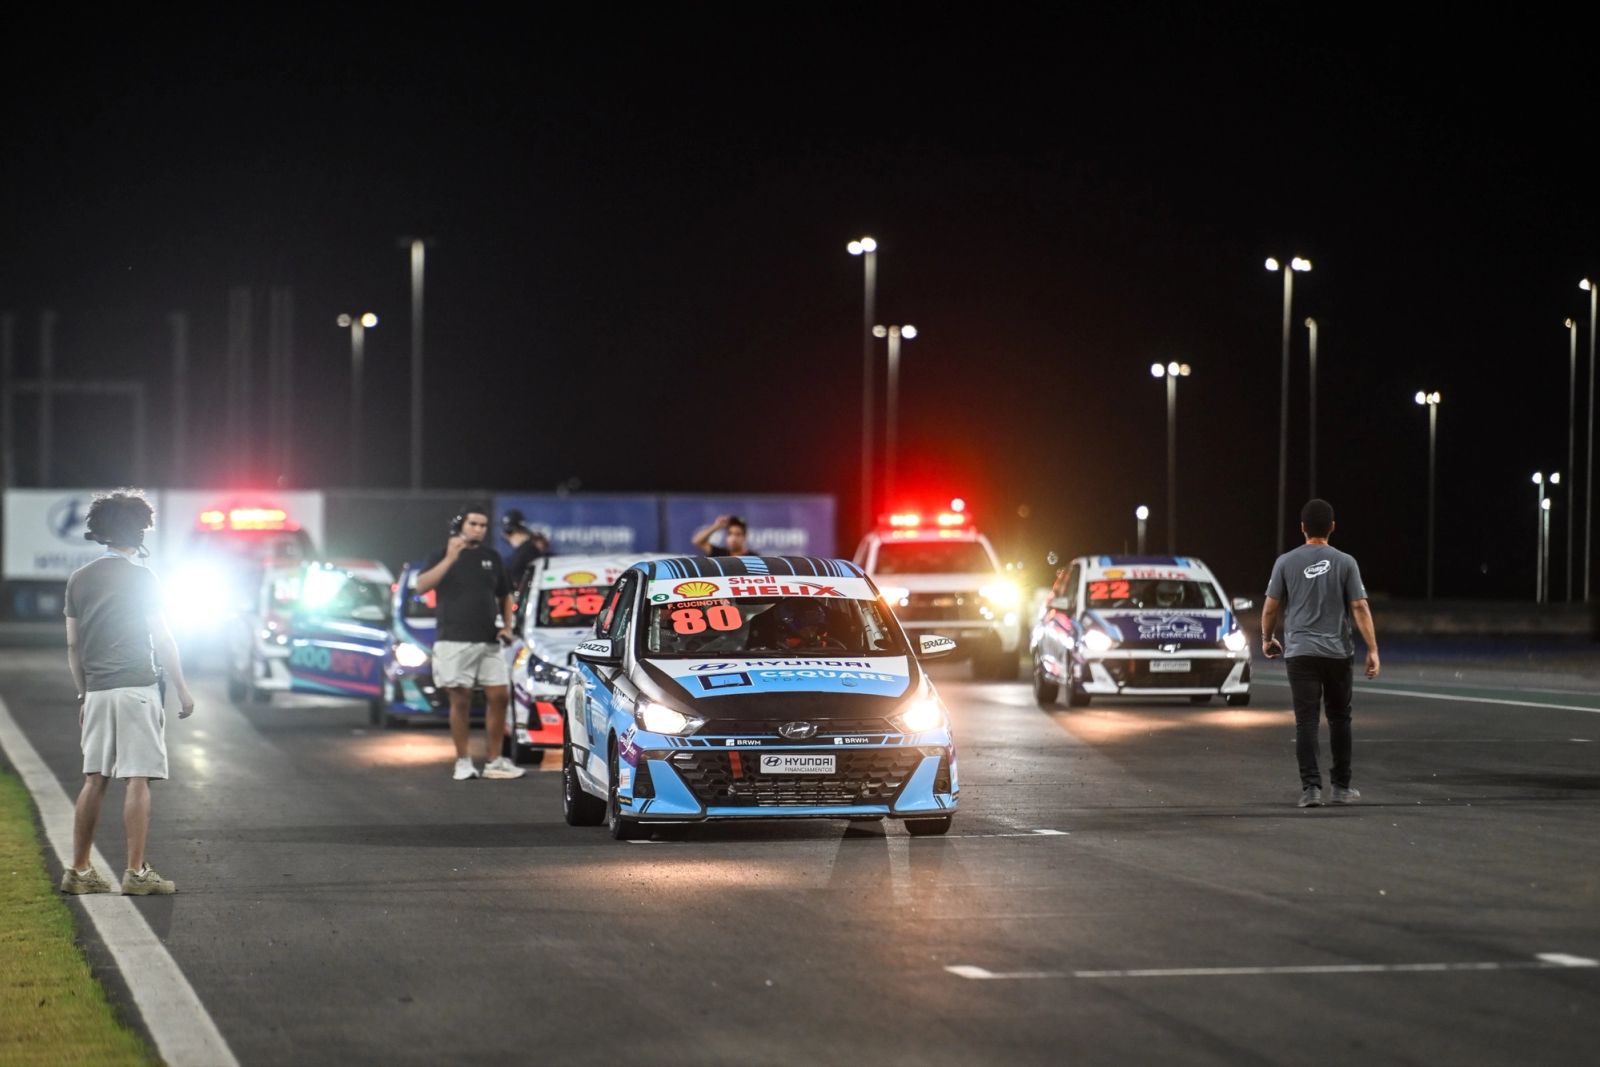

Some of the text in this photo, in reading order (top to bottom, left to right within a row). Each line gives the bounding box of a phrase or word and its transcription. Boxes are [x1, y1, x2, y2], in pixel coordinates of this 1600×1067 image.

[728, 576, 776, 585] Shell
[729, 584, 845, 597] HELIX
[1088, 579, 1131, 600] 22
[676, 598, 731, 608] CUCINOTTA
[671, 605, 743, 635] 80
[745, 660, 871, 669] HYUNDAI
[759, 671, 895, 683] CSQUARE
[784, 757, 834, 767] HYUNDAI
